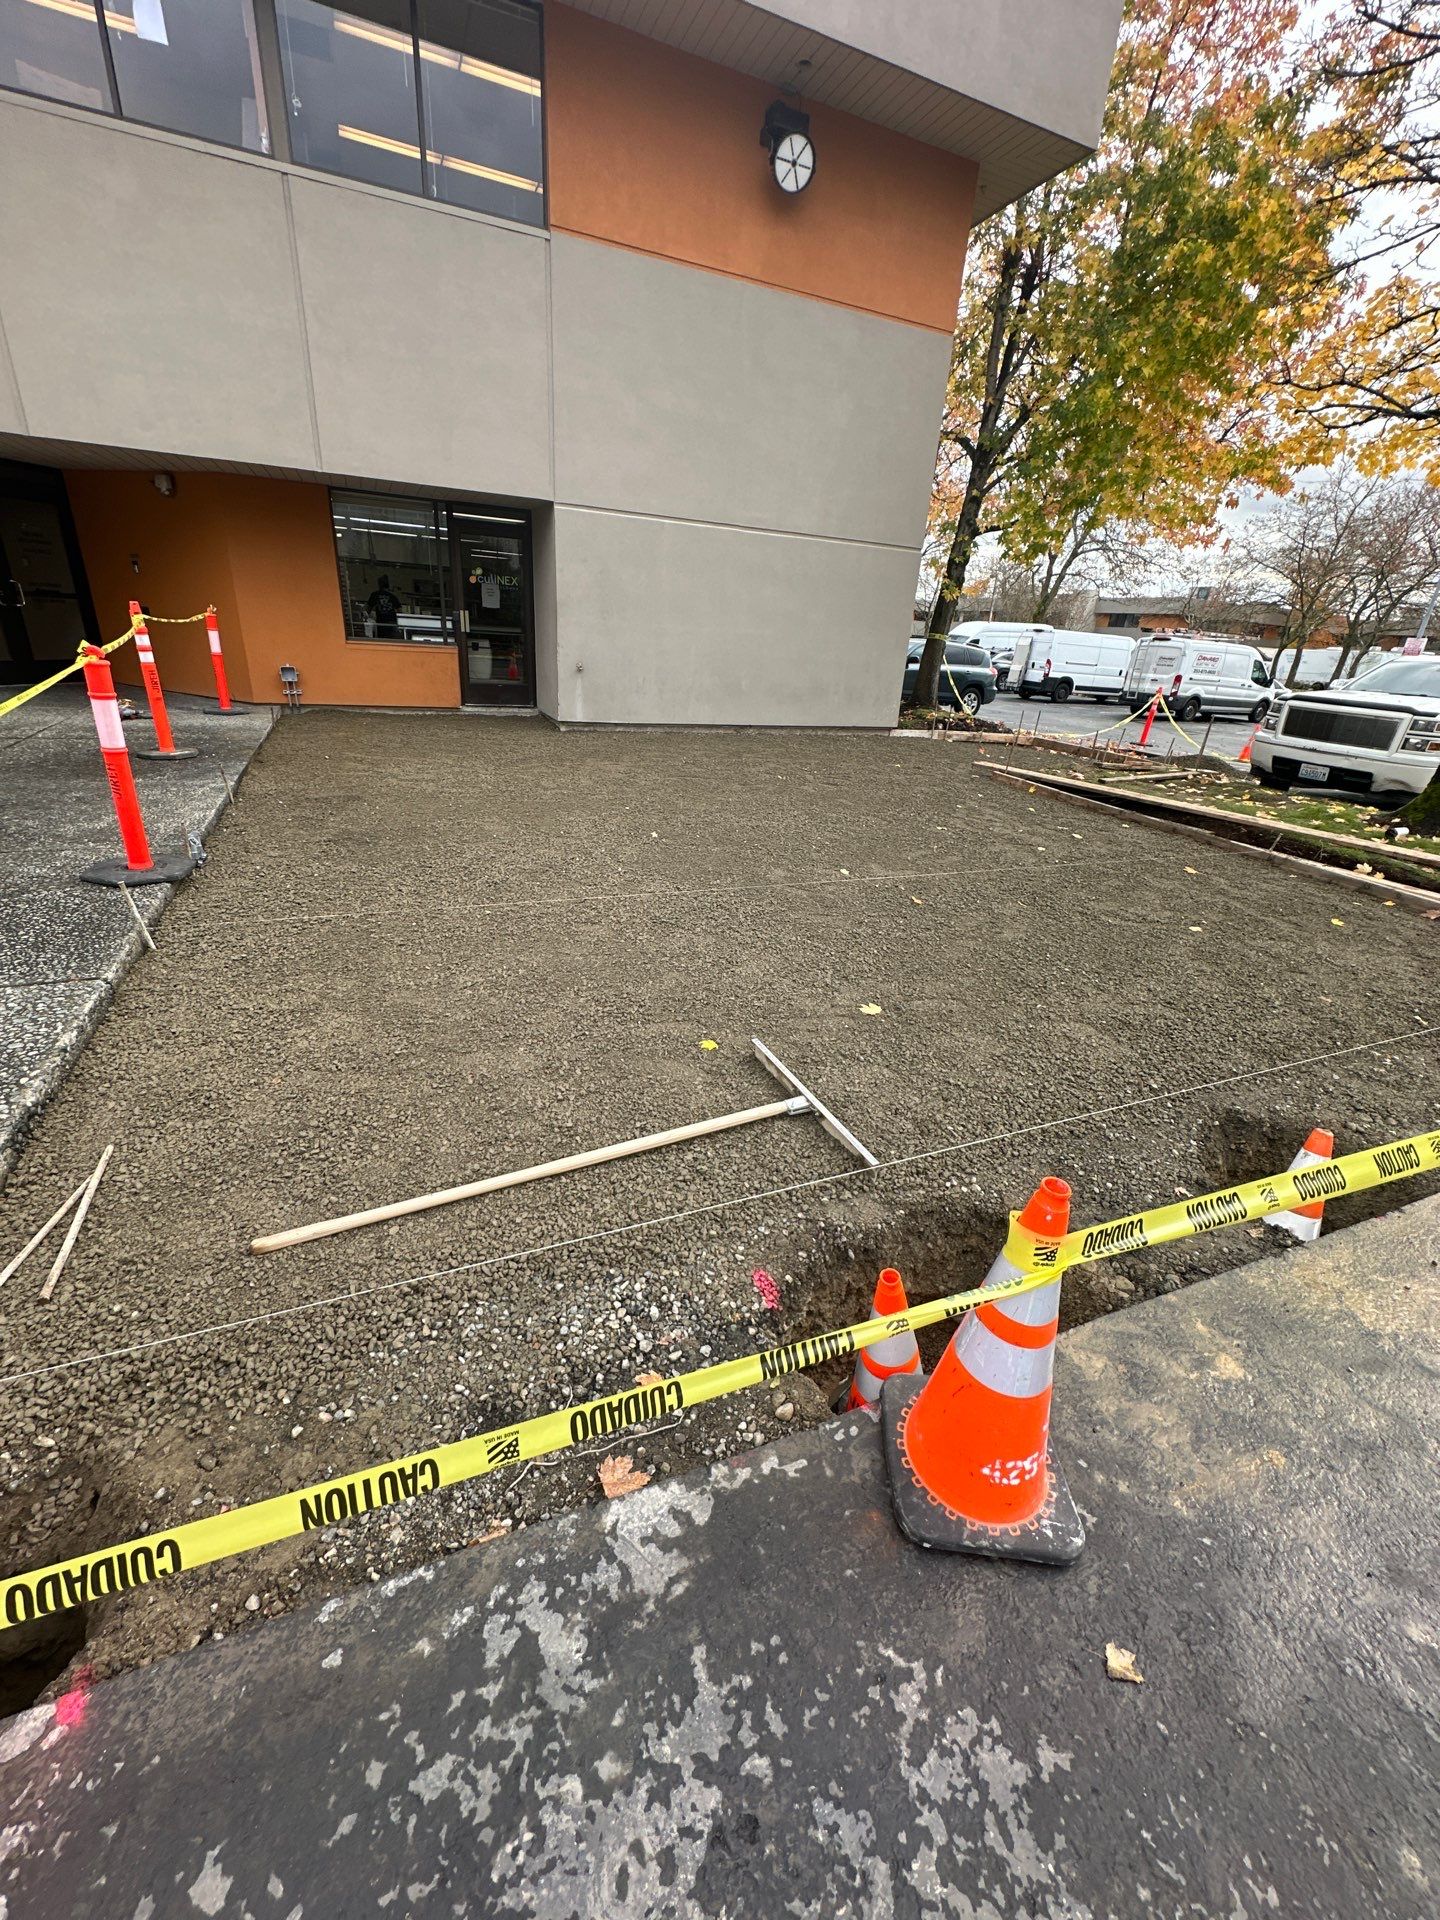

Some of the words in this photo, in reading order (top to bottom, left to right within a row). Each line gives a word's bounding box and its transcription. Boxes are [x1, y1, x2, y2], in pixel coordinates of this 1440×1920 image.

[106, 763, 121, 799] JIREH
[1373, 1143, 1420, 1179] CAUTION
[1293, 1164, 1347, 1201] CUIDADO
[1186, 1192, 1248, 1232] CAUTION
[1081, 1218, 1149, 1258] CUIDADO
[570, 1381, 683, 1443] CUIDADO
[300, 1458, 440, 1531] CAUTION
[6, 1539, 182, 1624] CUIDADO
